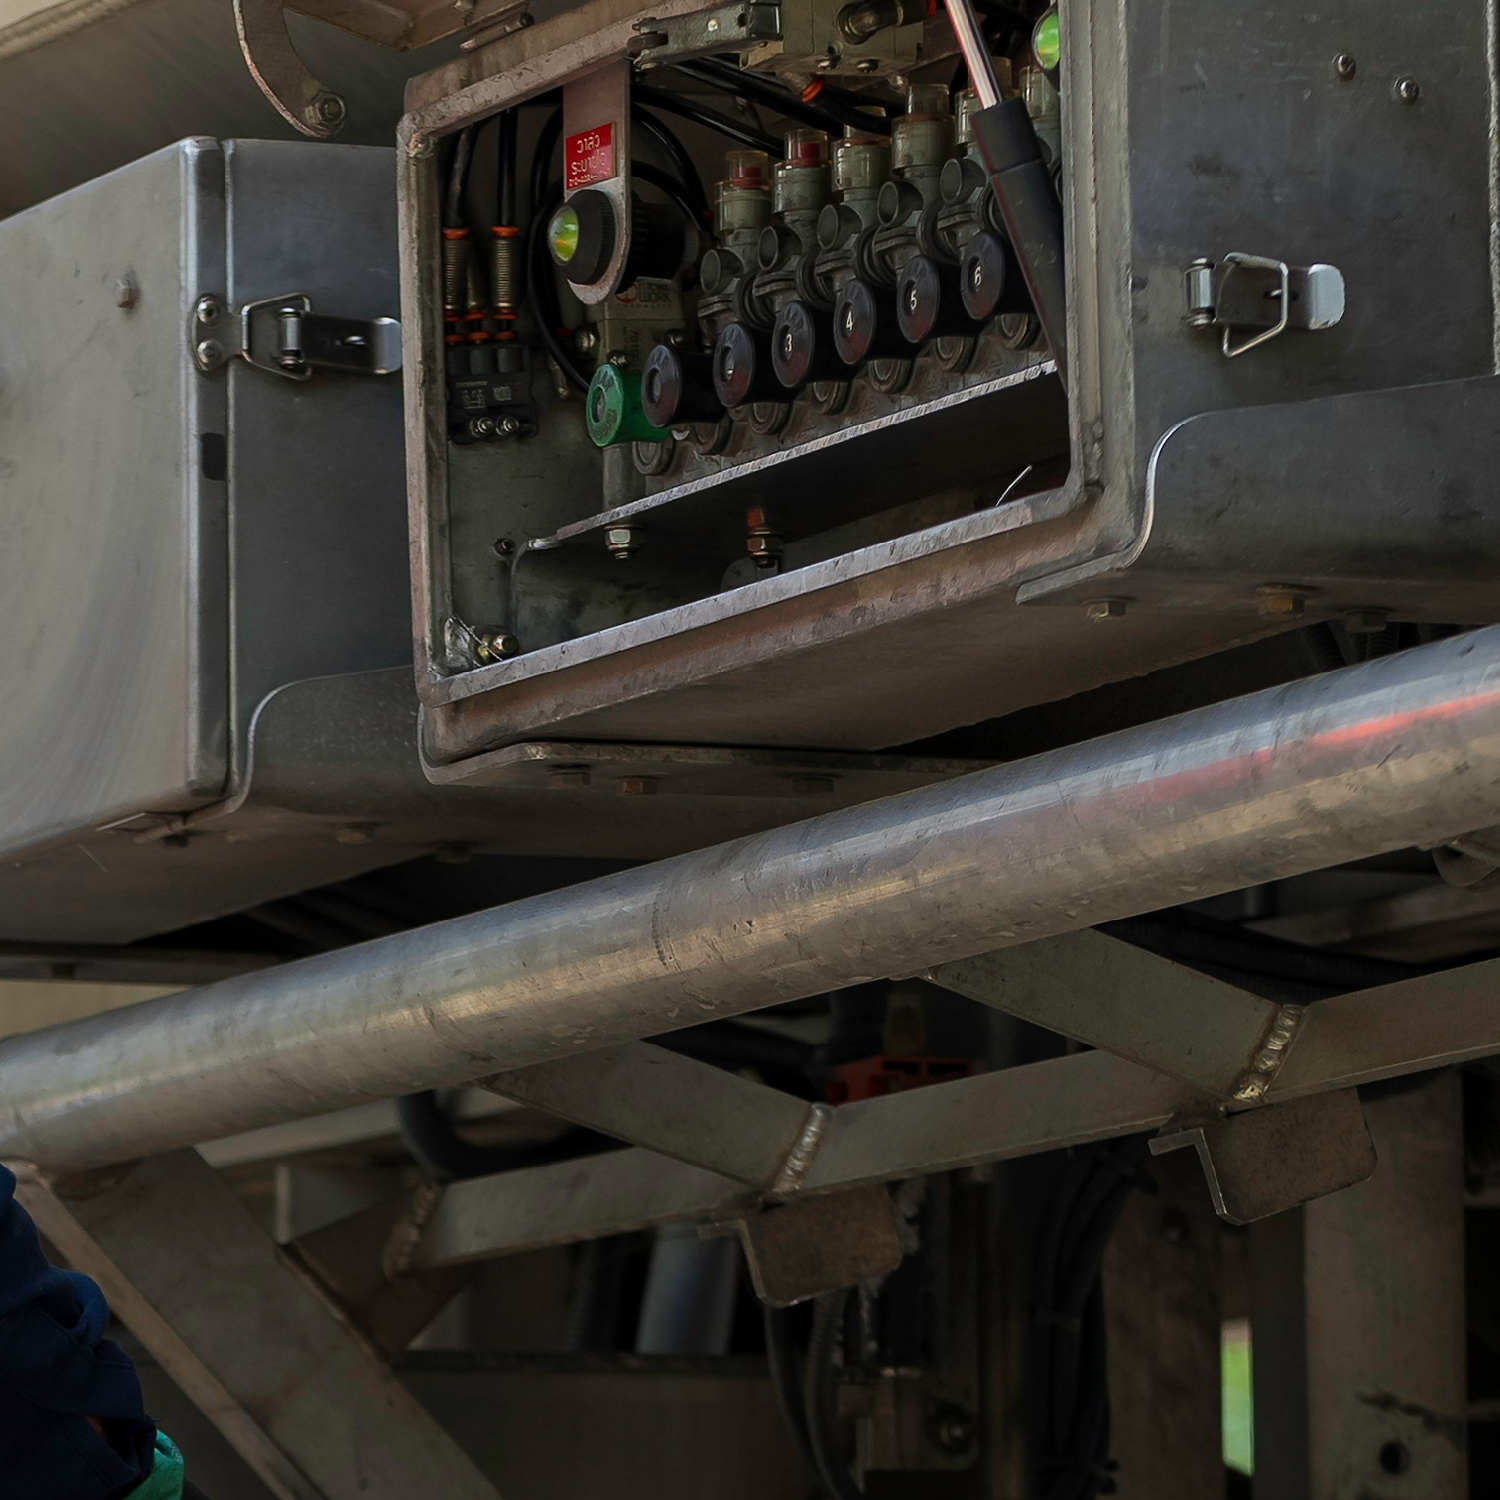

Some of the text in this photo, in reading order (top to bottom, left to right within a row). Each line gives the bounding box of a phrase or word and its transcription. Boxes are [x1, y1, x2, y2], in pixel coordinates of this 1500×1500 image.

[973, 265, 983, 287] 6
[909, 288, 918, 311] 5
[845, 309, 854, 332] 4
[784, 332, 793, 352] 3
